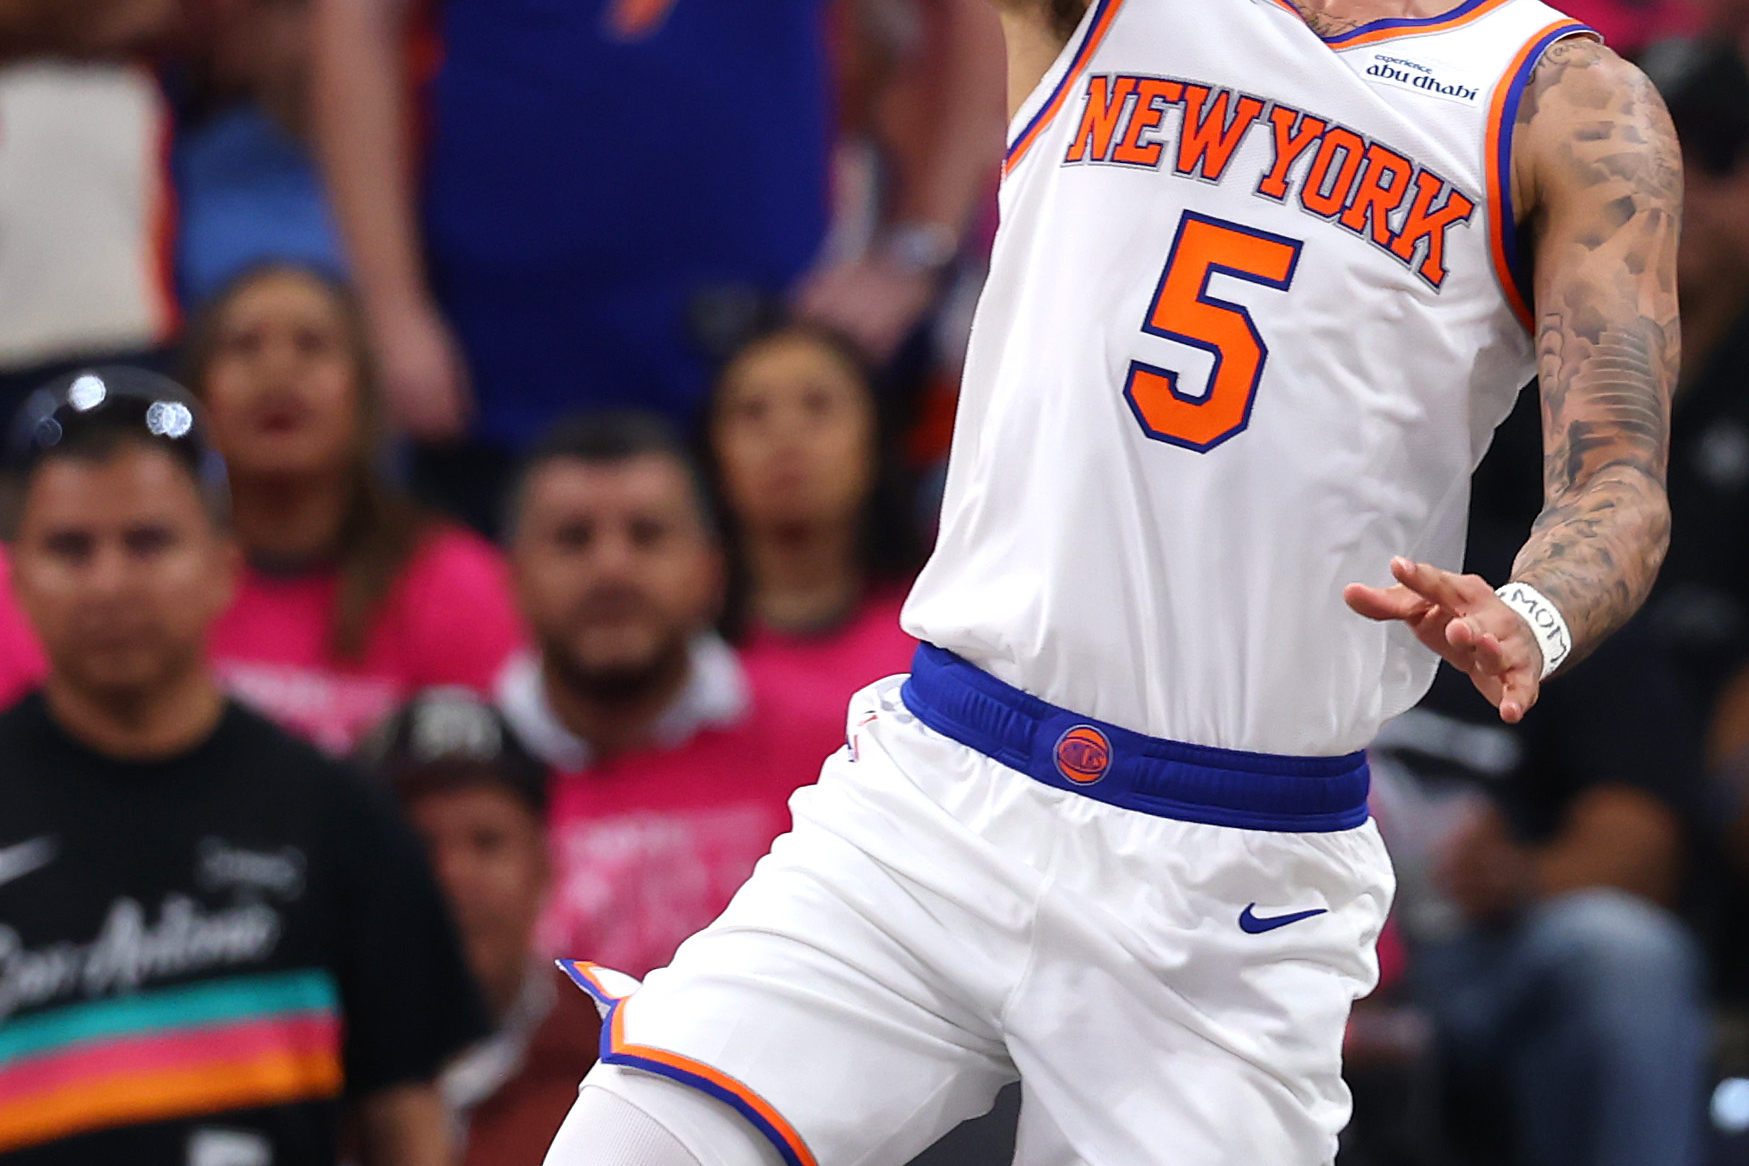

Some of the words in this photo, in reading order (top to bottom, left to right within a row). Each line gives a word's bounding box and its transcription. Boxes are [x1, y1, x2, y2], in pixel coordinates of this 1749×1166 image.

[1365, 63, 1411, 84] abu
[1411, 75, 1480, 101] dhabi
[1374, 53, 1433, 75] experience
[1060, 72, 1267, 186] NEW
[1253, 102, 1481, 295] YORK
[1122, 208, 1305, 455] 5
[1510, 587, 1568, 664] MOM
